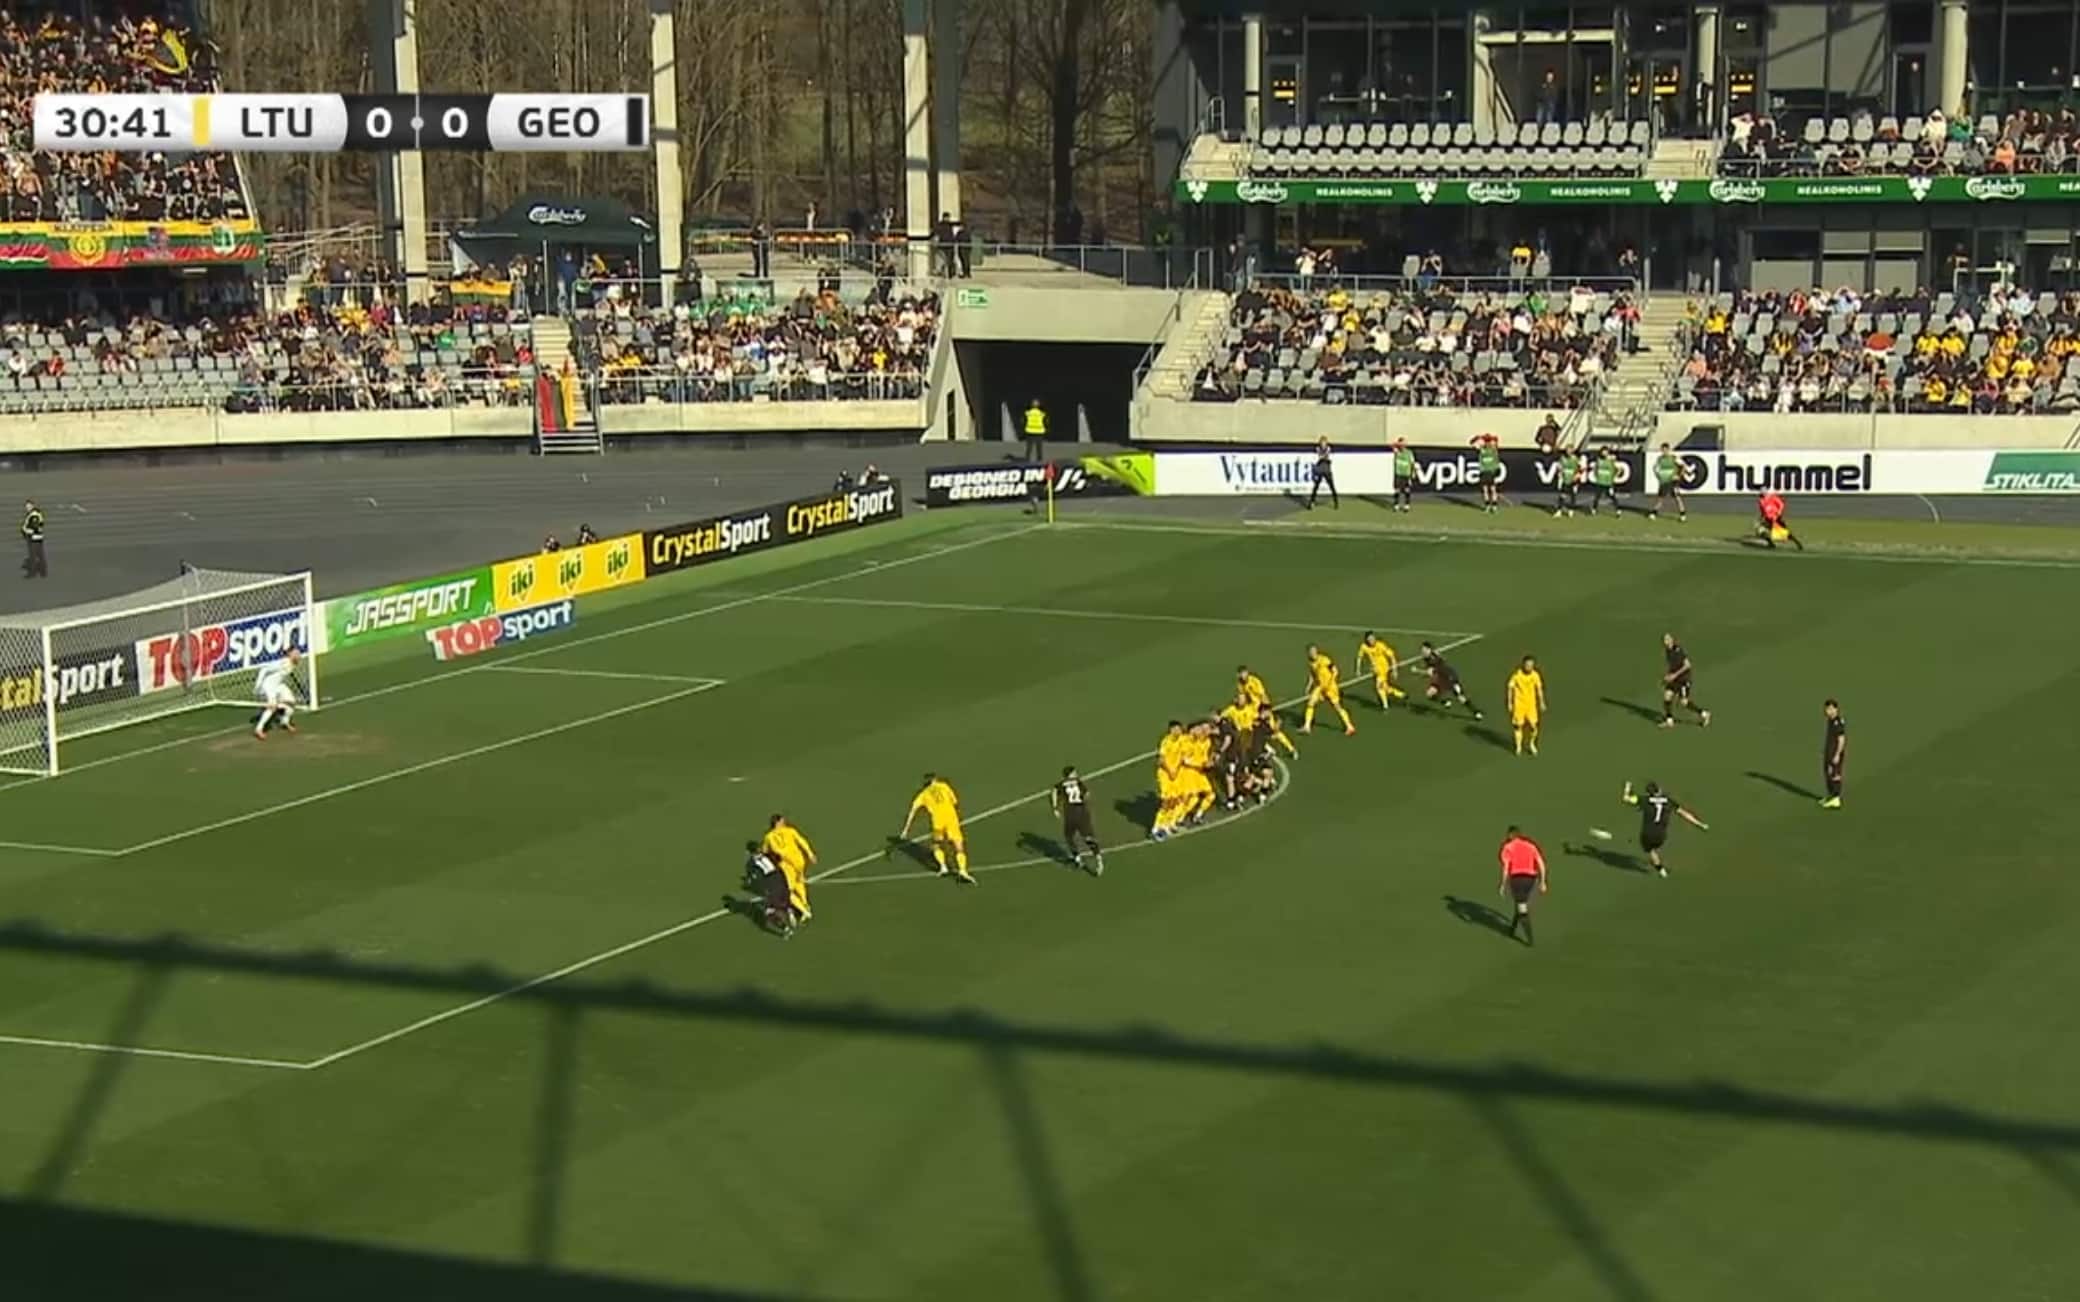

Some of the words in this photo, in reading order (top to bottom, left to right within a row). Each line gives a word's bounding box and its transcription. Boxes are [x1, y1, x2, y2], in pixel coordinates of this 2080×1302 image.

[1236, 182, 1289, 203] Carlsberg
[1467, 182, 1521, 202] Carlsberg
[1709, 180, 1766, 202] Carlsberg
[1965, 178, 2026, 201] Carlsberg
[930, 470, 1022, 488] DESIGNED
[1717, 454, 1872, 491] hummel
[948, 482, 1028, 500] GEORGIA
[787, 485, 895, 535] CrystalSport
[652, 512, 771, 565] CrystalSport
[560, 554, 582, 586] iki
[608, 543, 630, 574] iki
[510, 565, 534, 596] iki
[346, 578, 477, 635] JASSPORT
